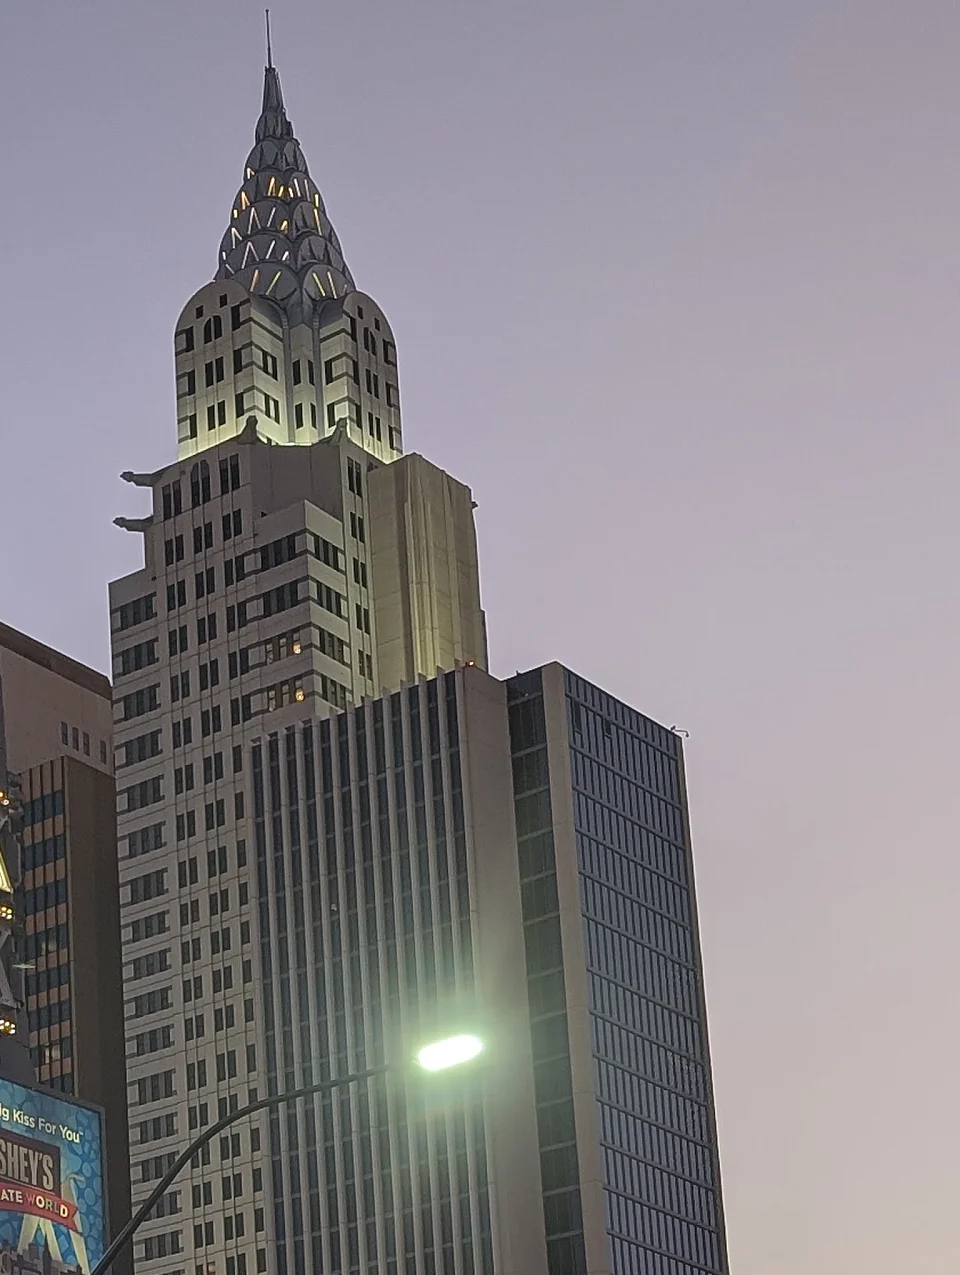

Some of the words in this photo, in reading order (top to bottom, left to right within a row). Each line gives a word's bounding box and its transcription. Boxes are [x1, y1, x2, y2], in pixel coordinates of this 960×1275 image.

[13, 1109, 36, 1129] Kiss
[38, 1118, 57, 1136] For
[25, 1191, 69, 1218] WORLD
